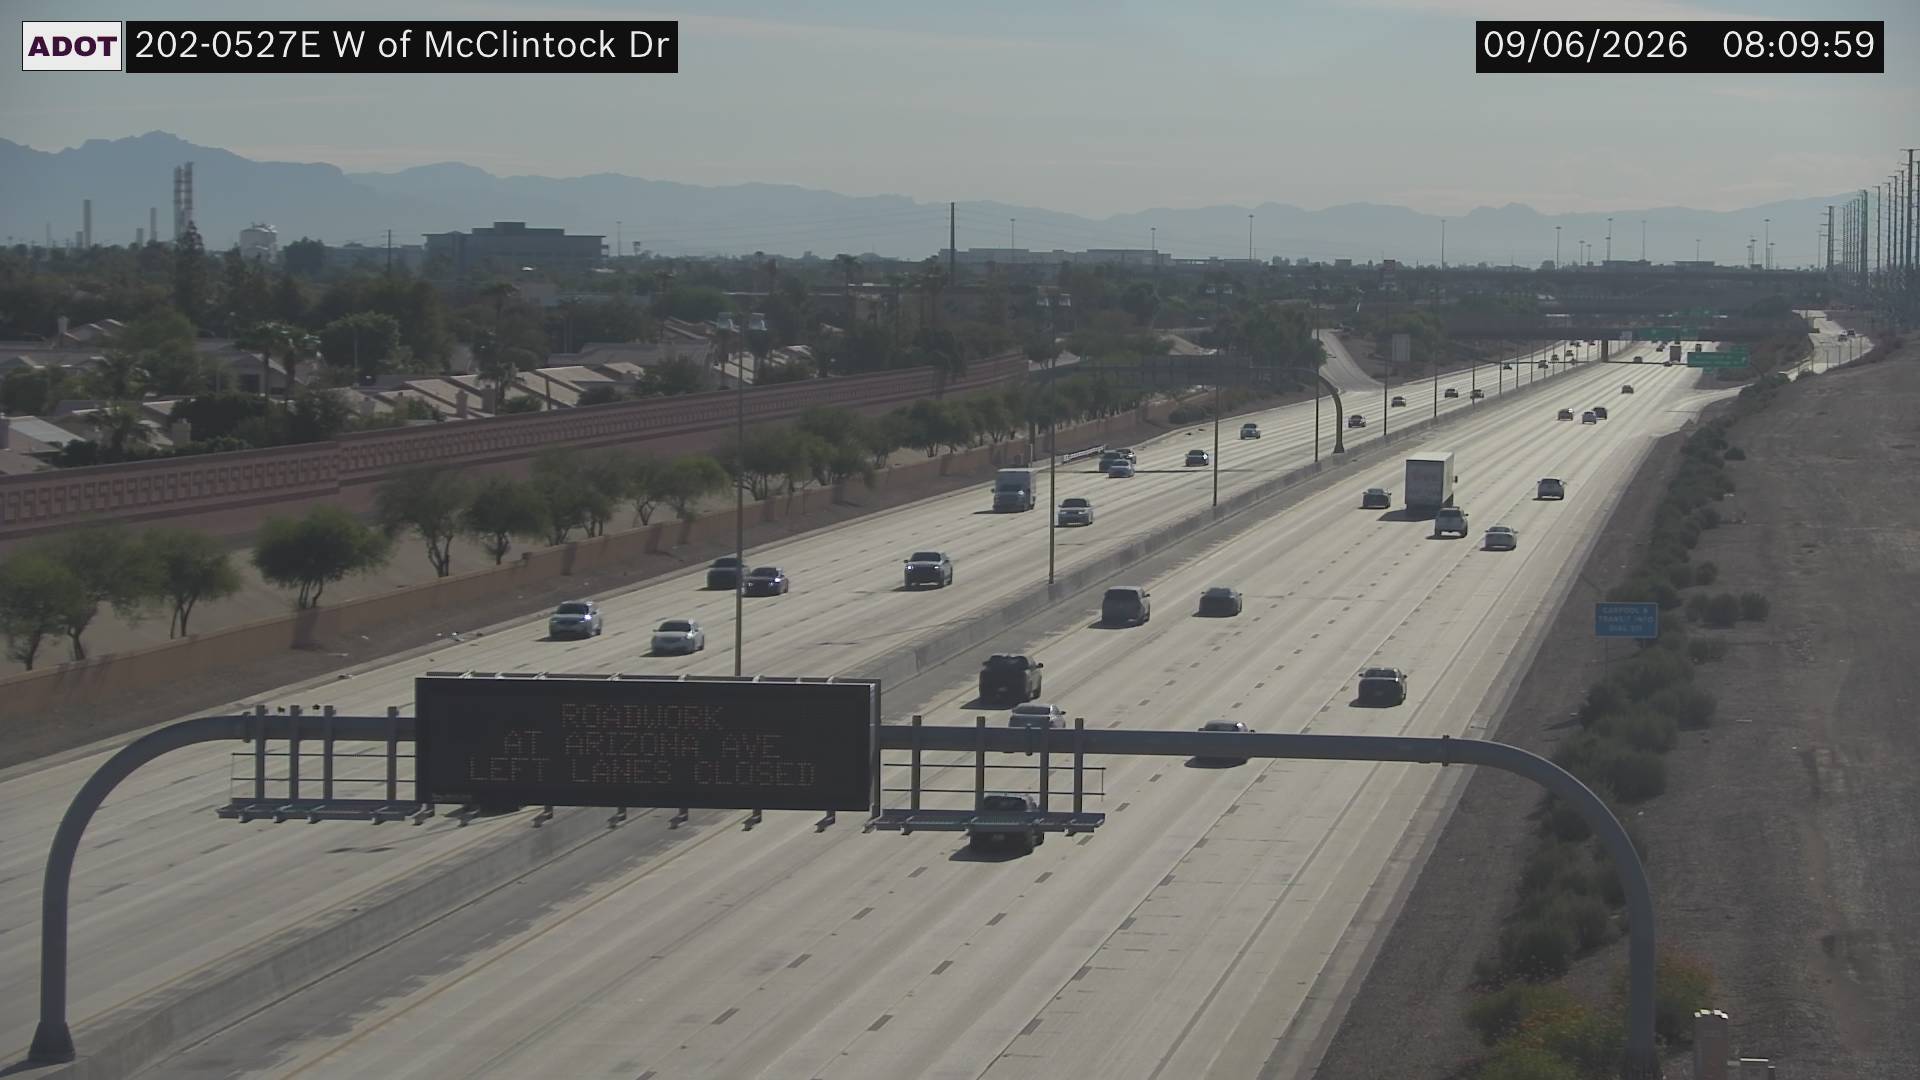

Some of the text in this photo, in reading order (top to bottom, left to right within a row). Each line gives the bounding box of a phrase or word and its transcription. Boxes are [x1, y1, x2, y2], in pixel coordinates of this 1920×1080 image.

[561, 703, 725, 730] ROADWORK
[502, 729, 783, 760] AT ARIZONA AVE
[468, 755, 816, 787] LEFT LANES CLOSED
